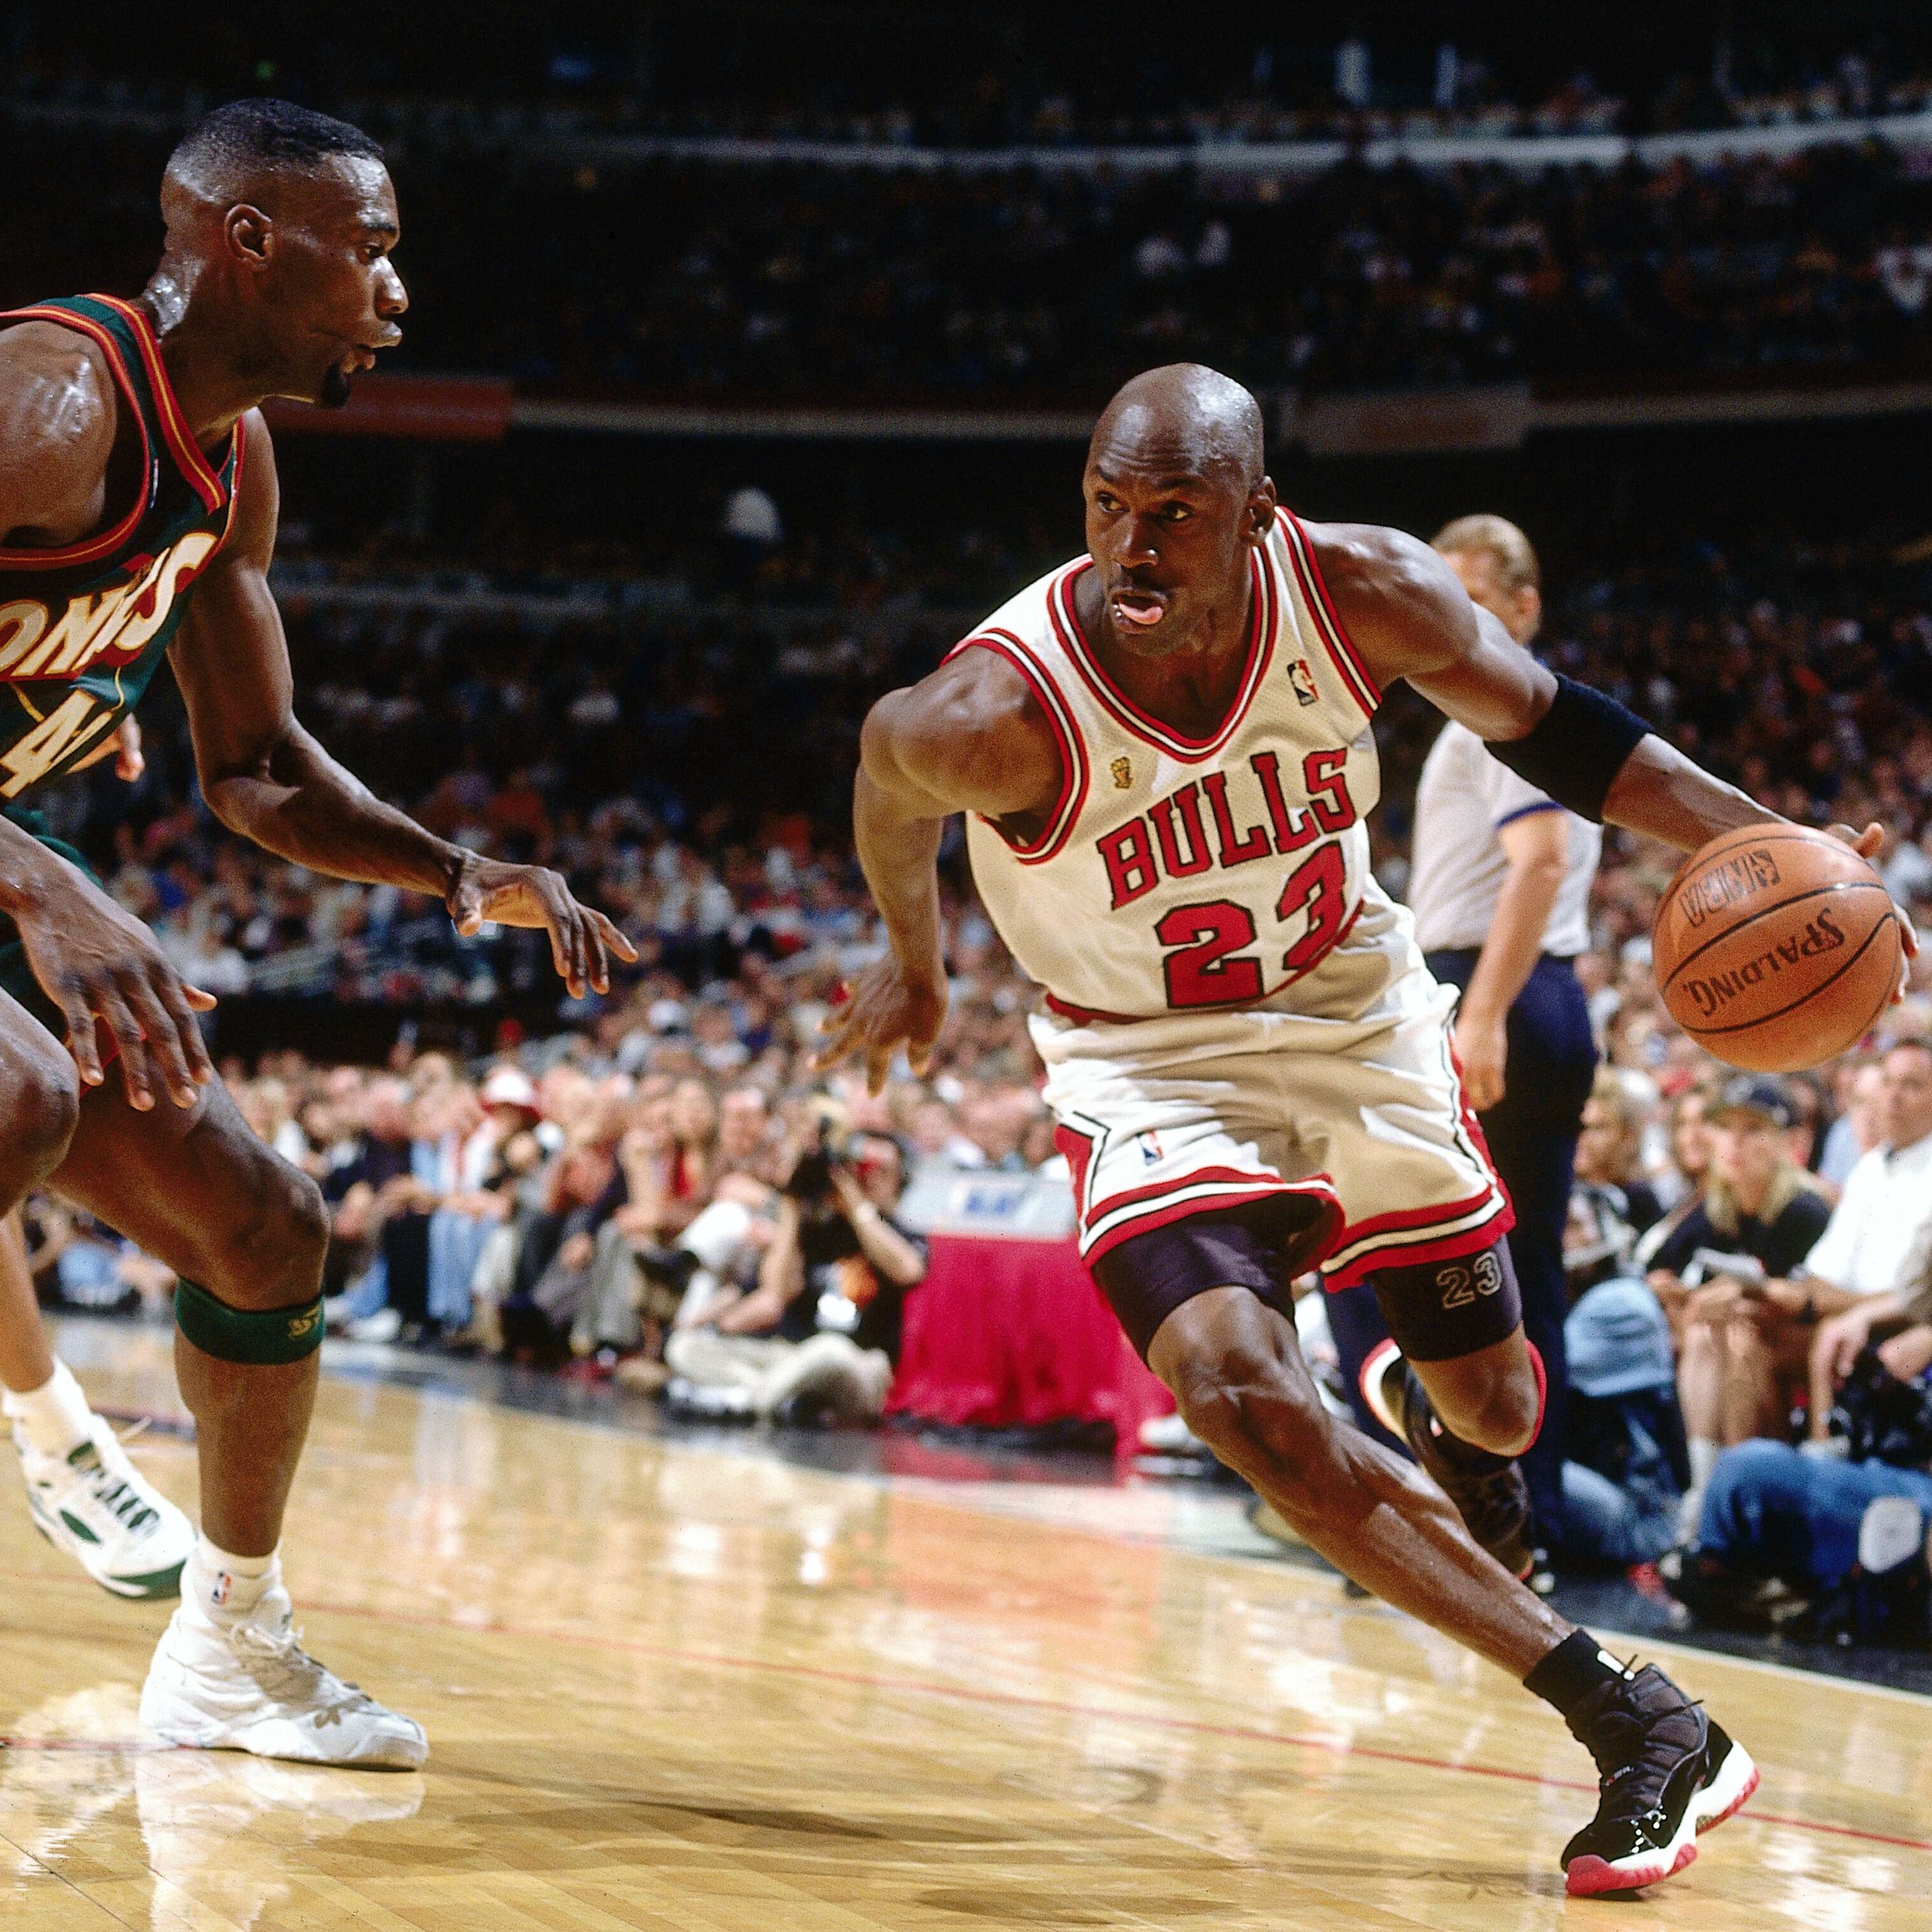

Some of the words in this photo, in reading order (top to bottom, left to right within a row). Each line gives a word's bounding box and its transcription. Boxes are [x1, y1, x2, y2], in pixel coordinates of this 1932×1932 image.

[1096, 748, 1355, 910] BULLS
[1154, 839, 1346, 1009] 23
[1687, 907, 1845, 1017] SPALDING
[1436, 1251, 1502, 1310] 23
